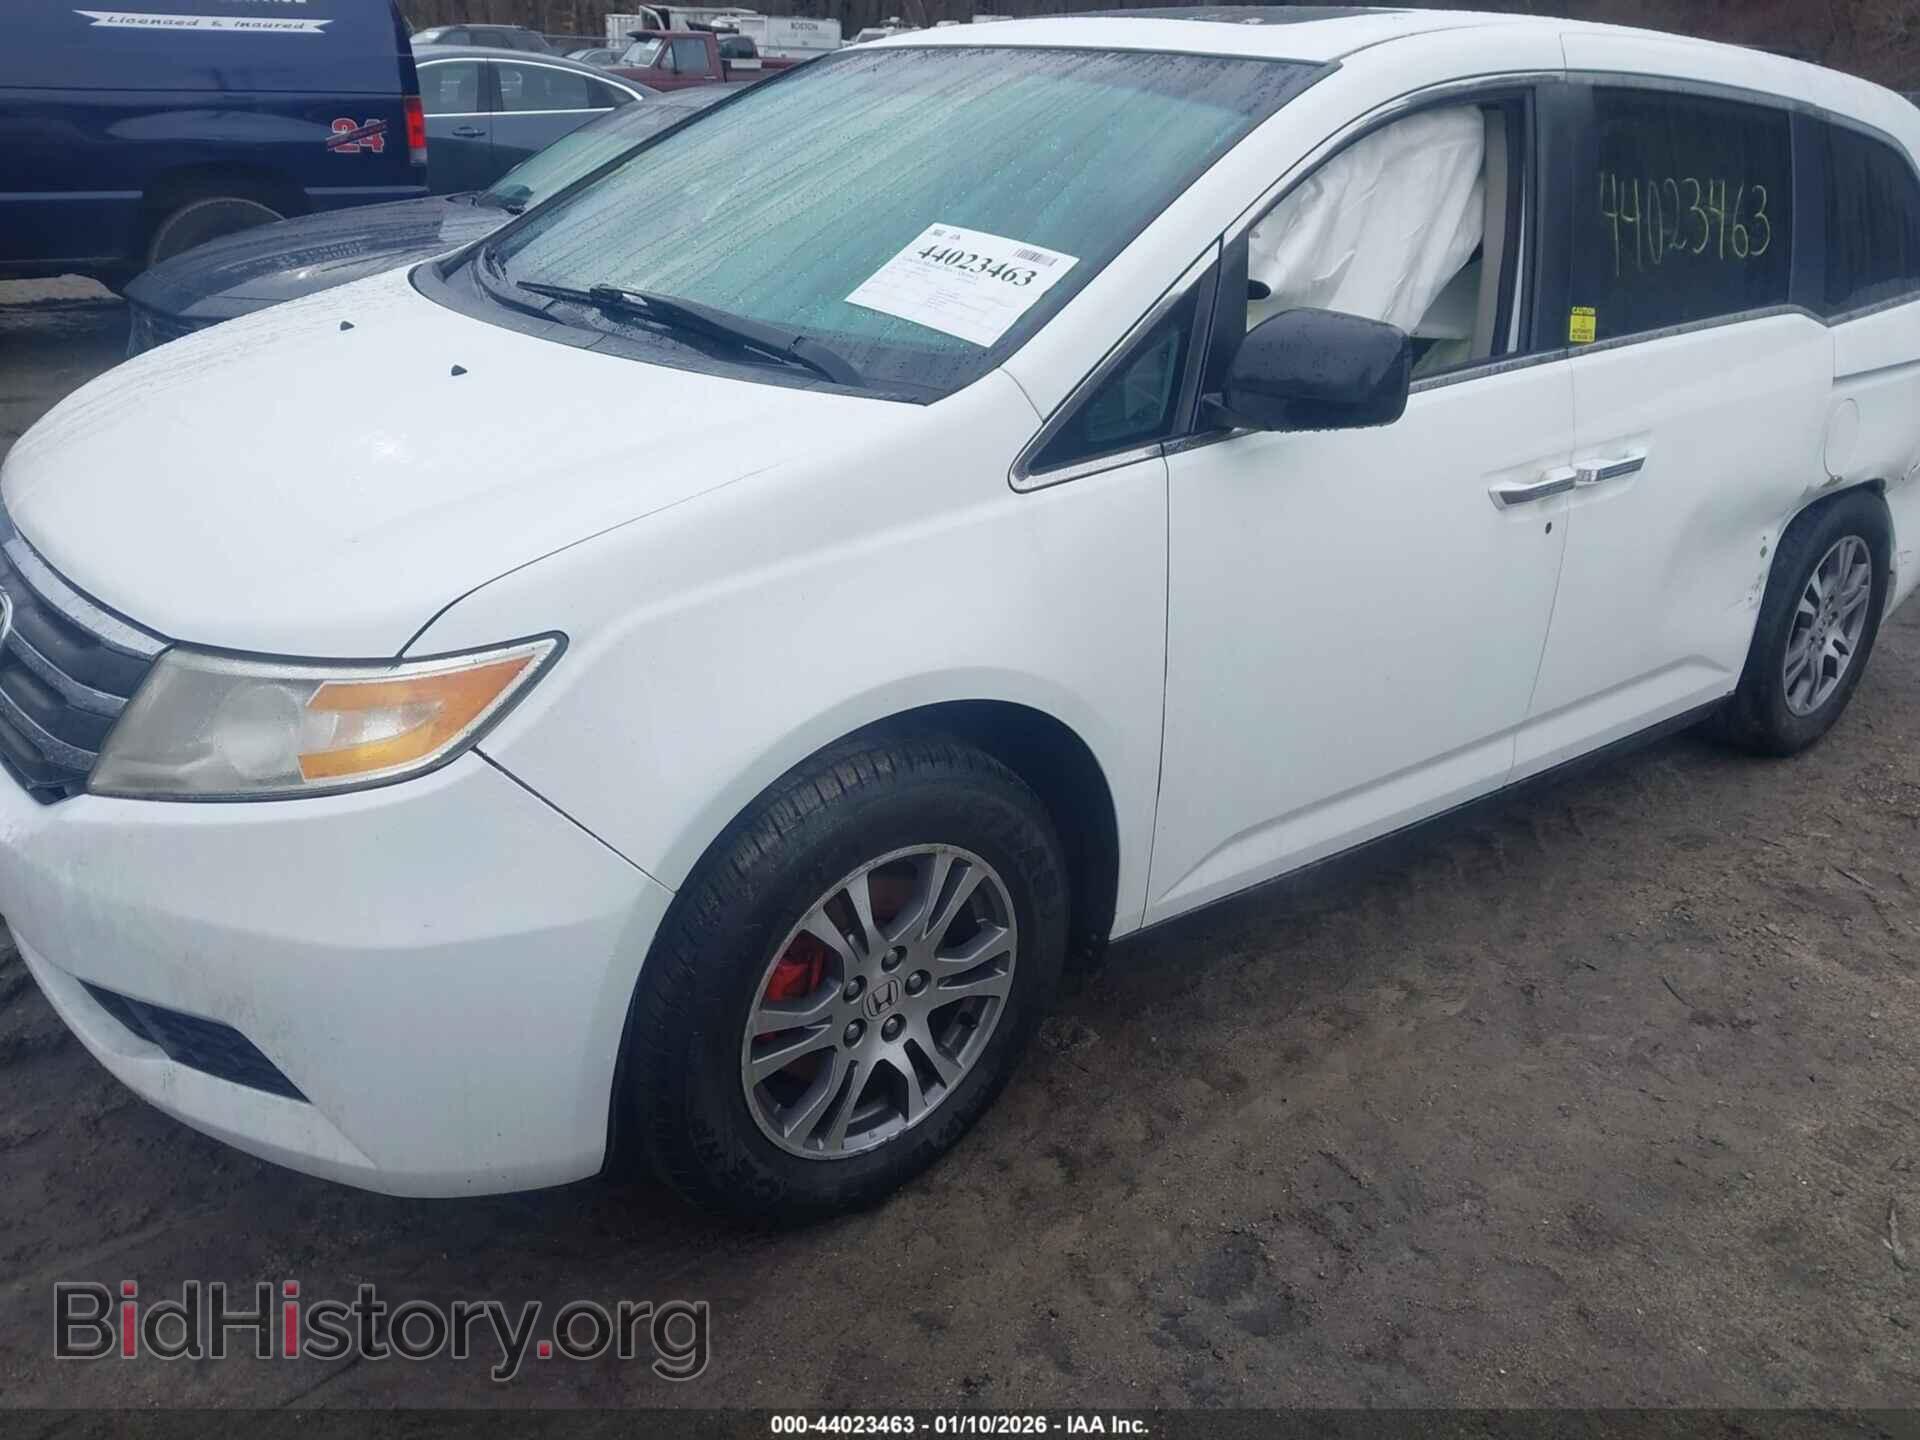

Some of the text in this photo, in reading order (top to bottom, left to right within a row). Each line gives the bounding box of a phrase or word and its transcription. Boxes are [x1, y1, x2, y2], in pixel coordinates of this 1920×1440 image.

[107, 16, 199, 26] Licensed
[234, 20, 304, 29] Insured
[1600, 171, 1771, 276] 44023463
[918, 244, 1037, 287] 44023463
